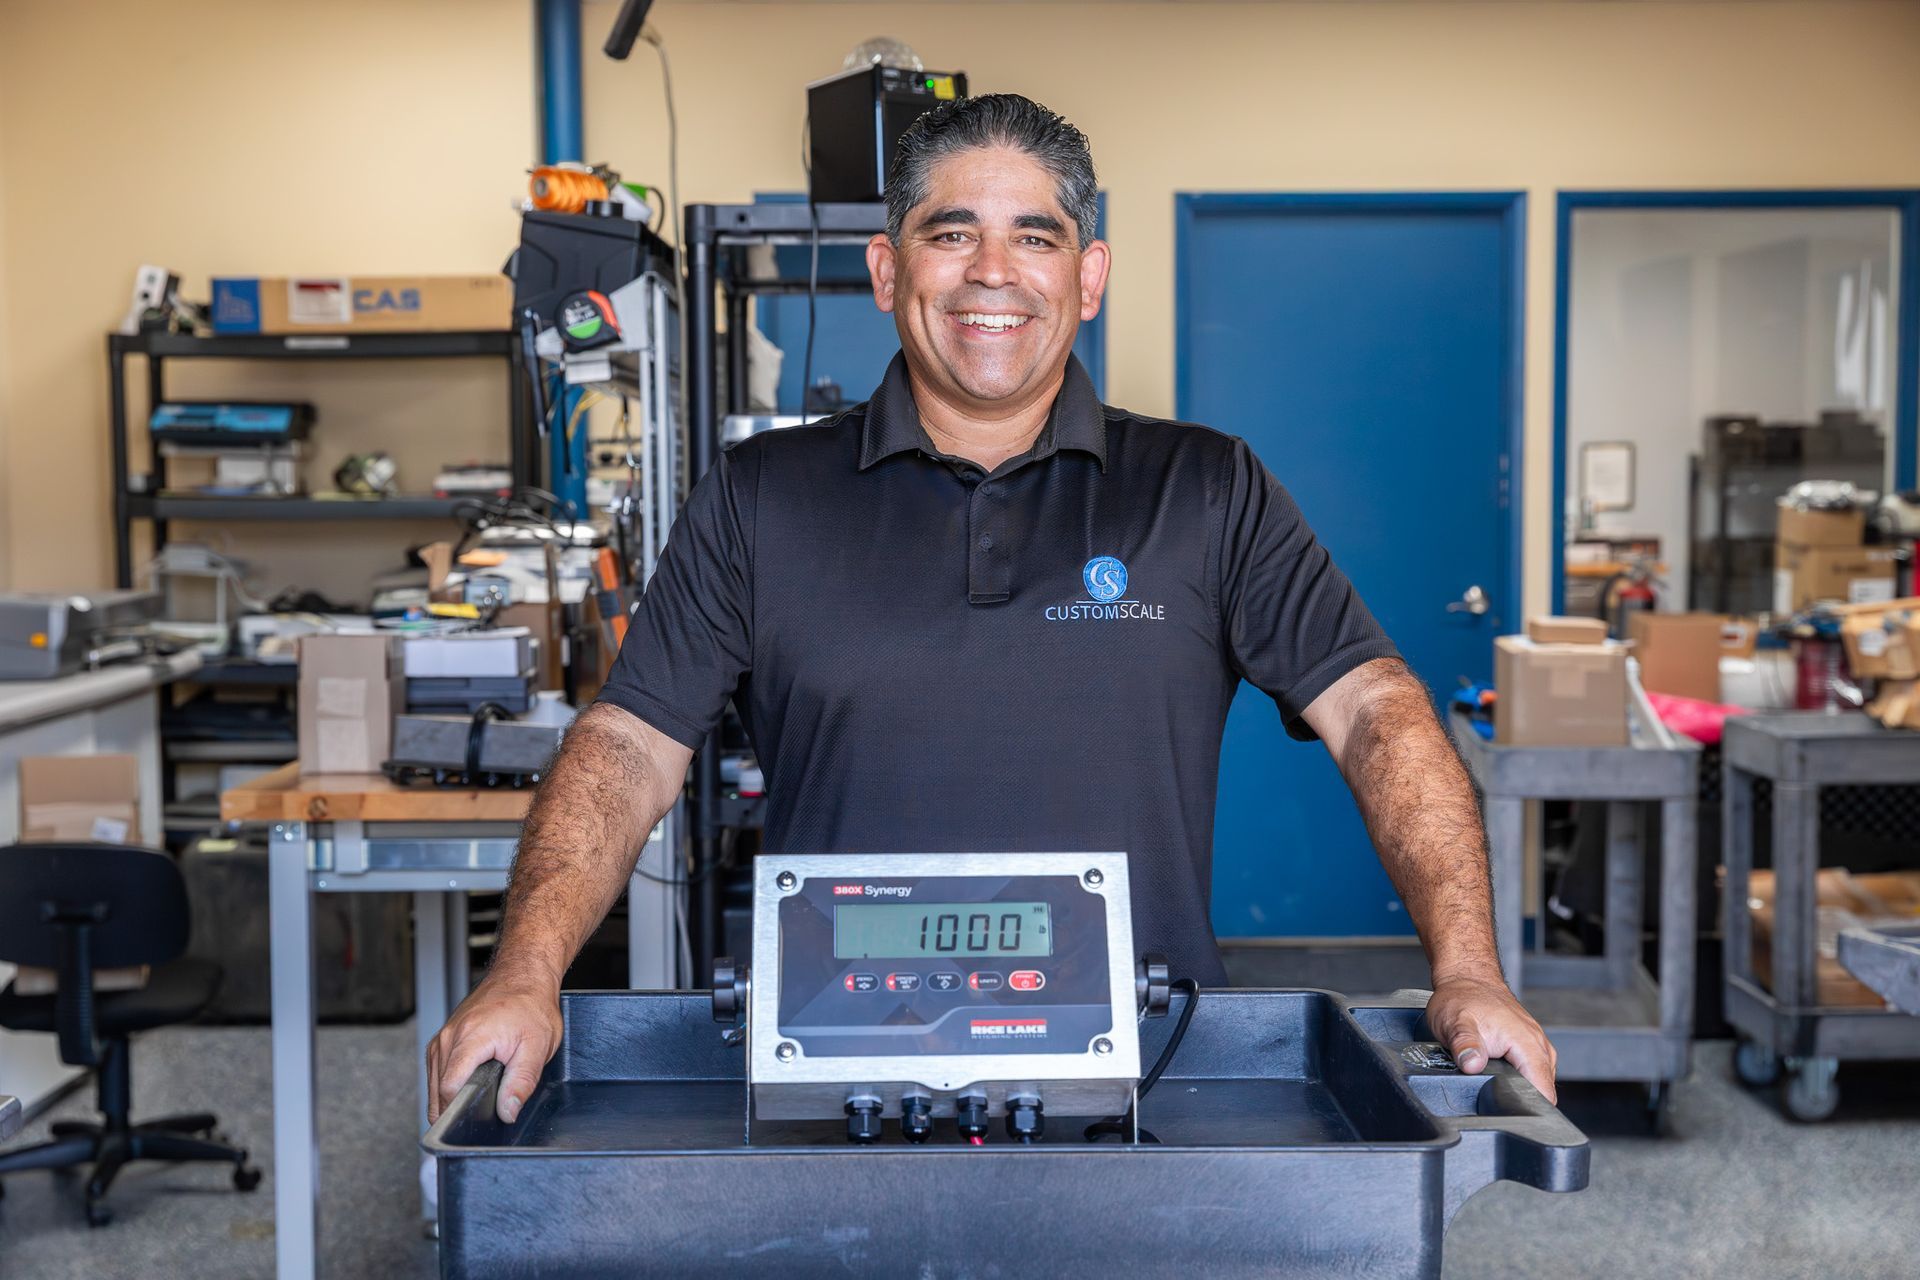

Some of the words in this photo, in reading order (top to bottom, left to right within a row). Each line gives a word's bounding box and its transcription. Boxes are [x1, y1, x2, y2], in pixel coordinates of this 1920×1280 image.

[352, 289, 421, 311] CAS
[1045, 604, 1165, 620] CUSTOMSCALE
[833, 886, 863, 895] 380X
[864, 885, 913, 898] Synergy
[920, 914, 1022, 951] 1000
[971, 1025, 1005, 1034] RICE
[1006, 1025, 1047, 1034] LAKE
